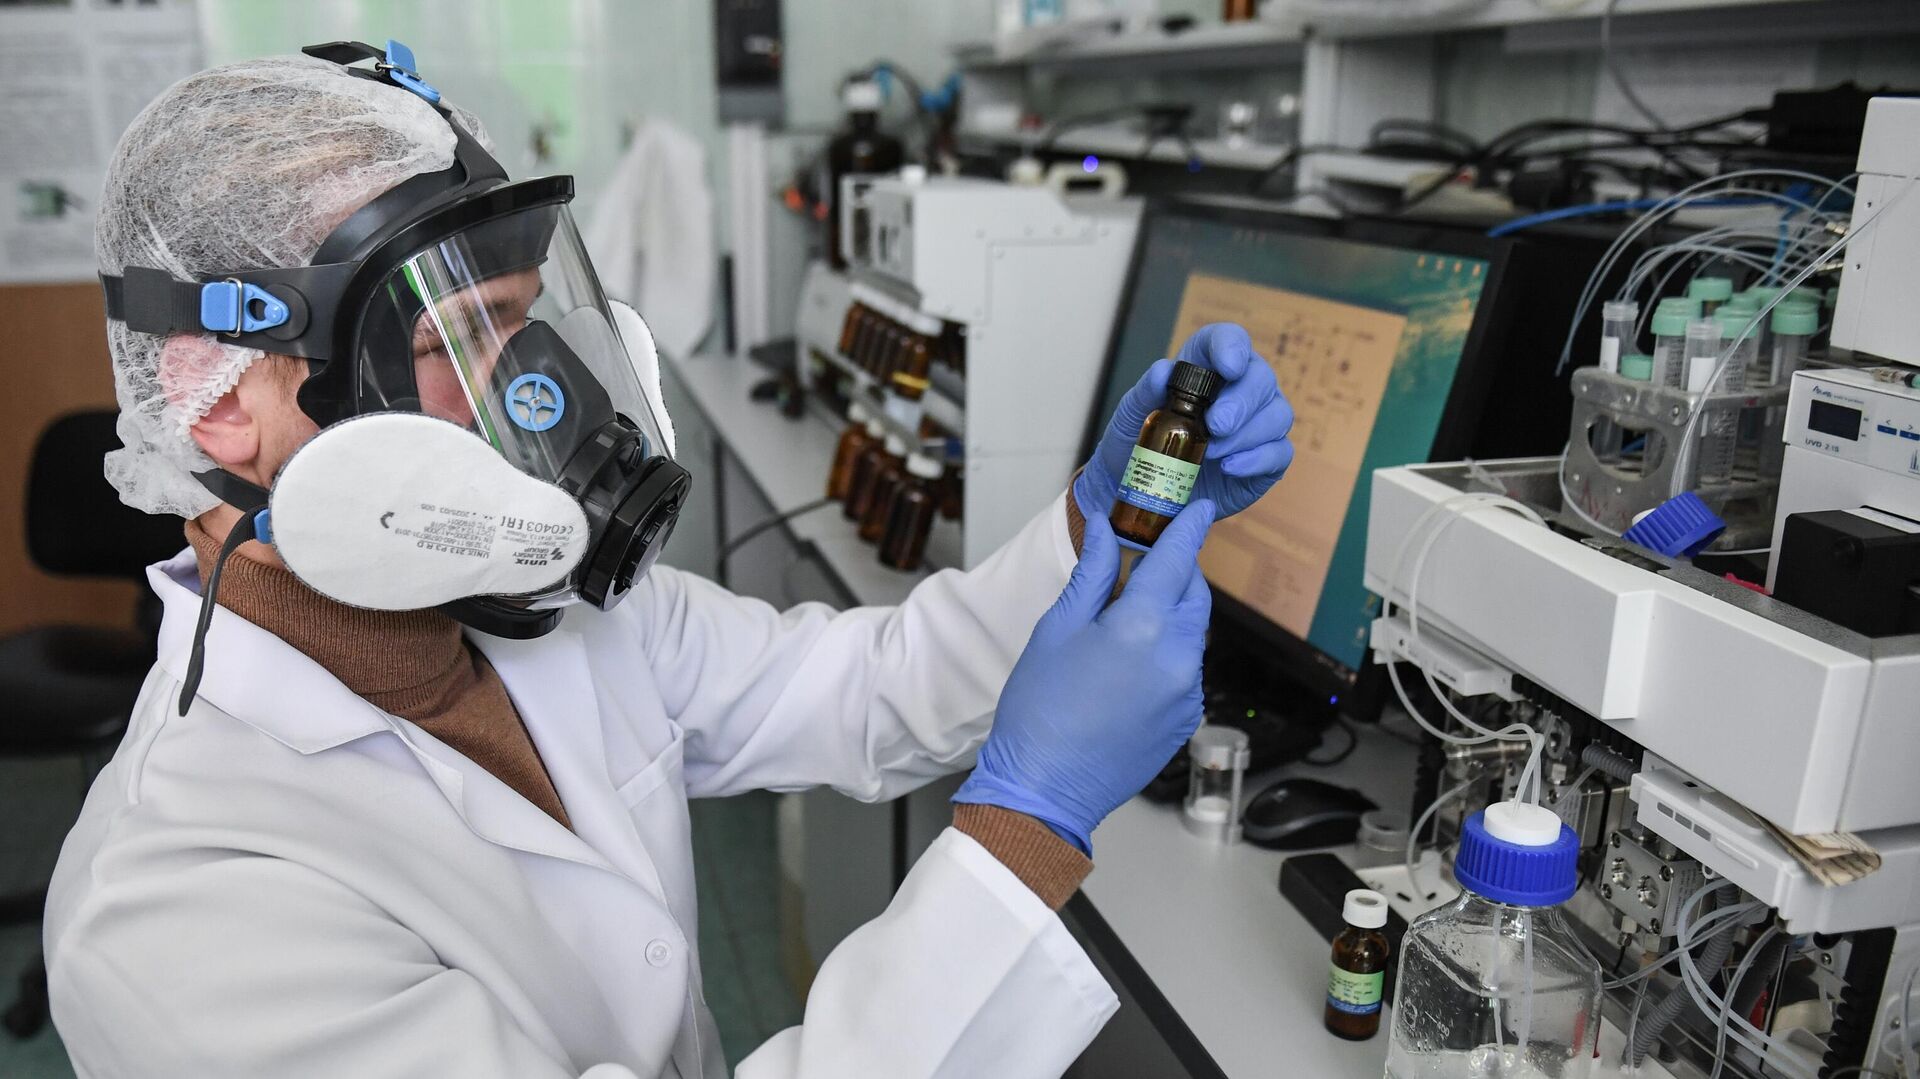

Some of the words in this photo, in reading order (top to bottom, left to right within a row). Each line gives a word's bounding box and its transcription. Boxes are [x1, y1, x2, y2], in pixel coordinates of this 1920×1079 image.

[1805, 439, 1822, 448] UVD
[1138, 458, 1164, 470] Guanosine
[468, 549, 489, 558] UNIX
